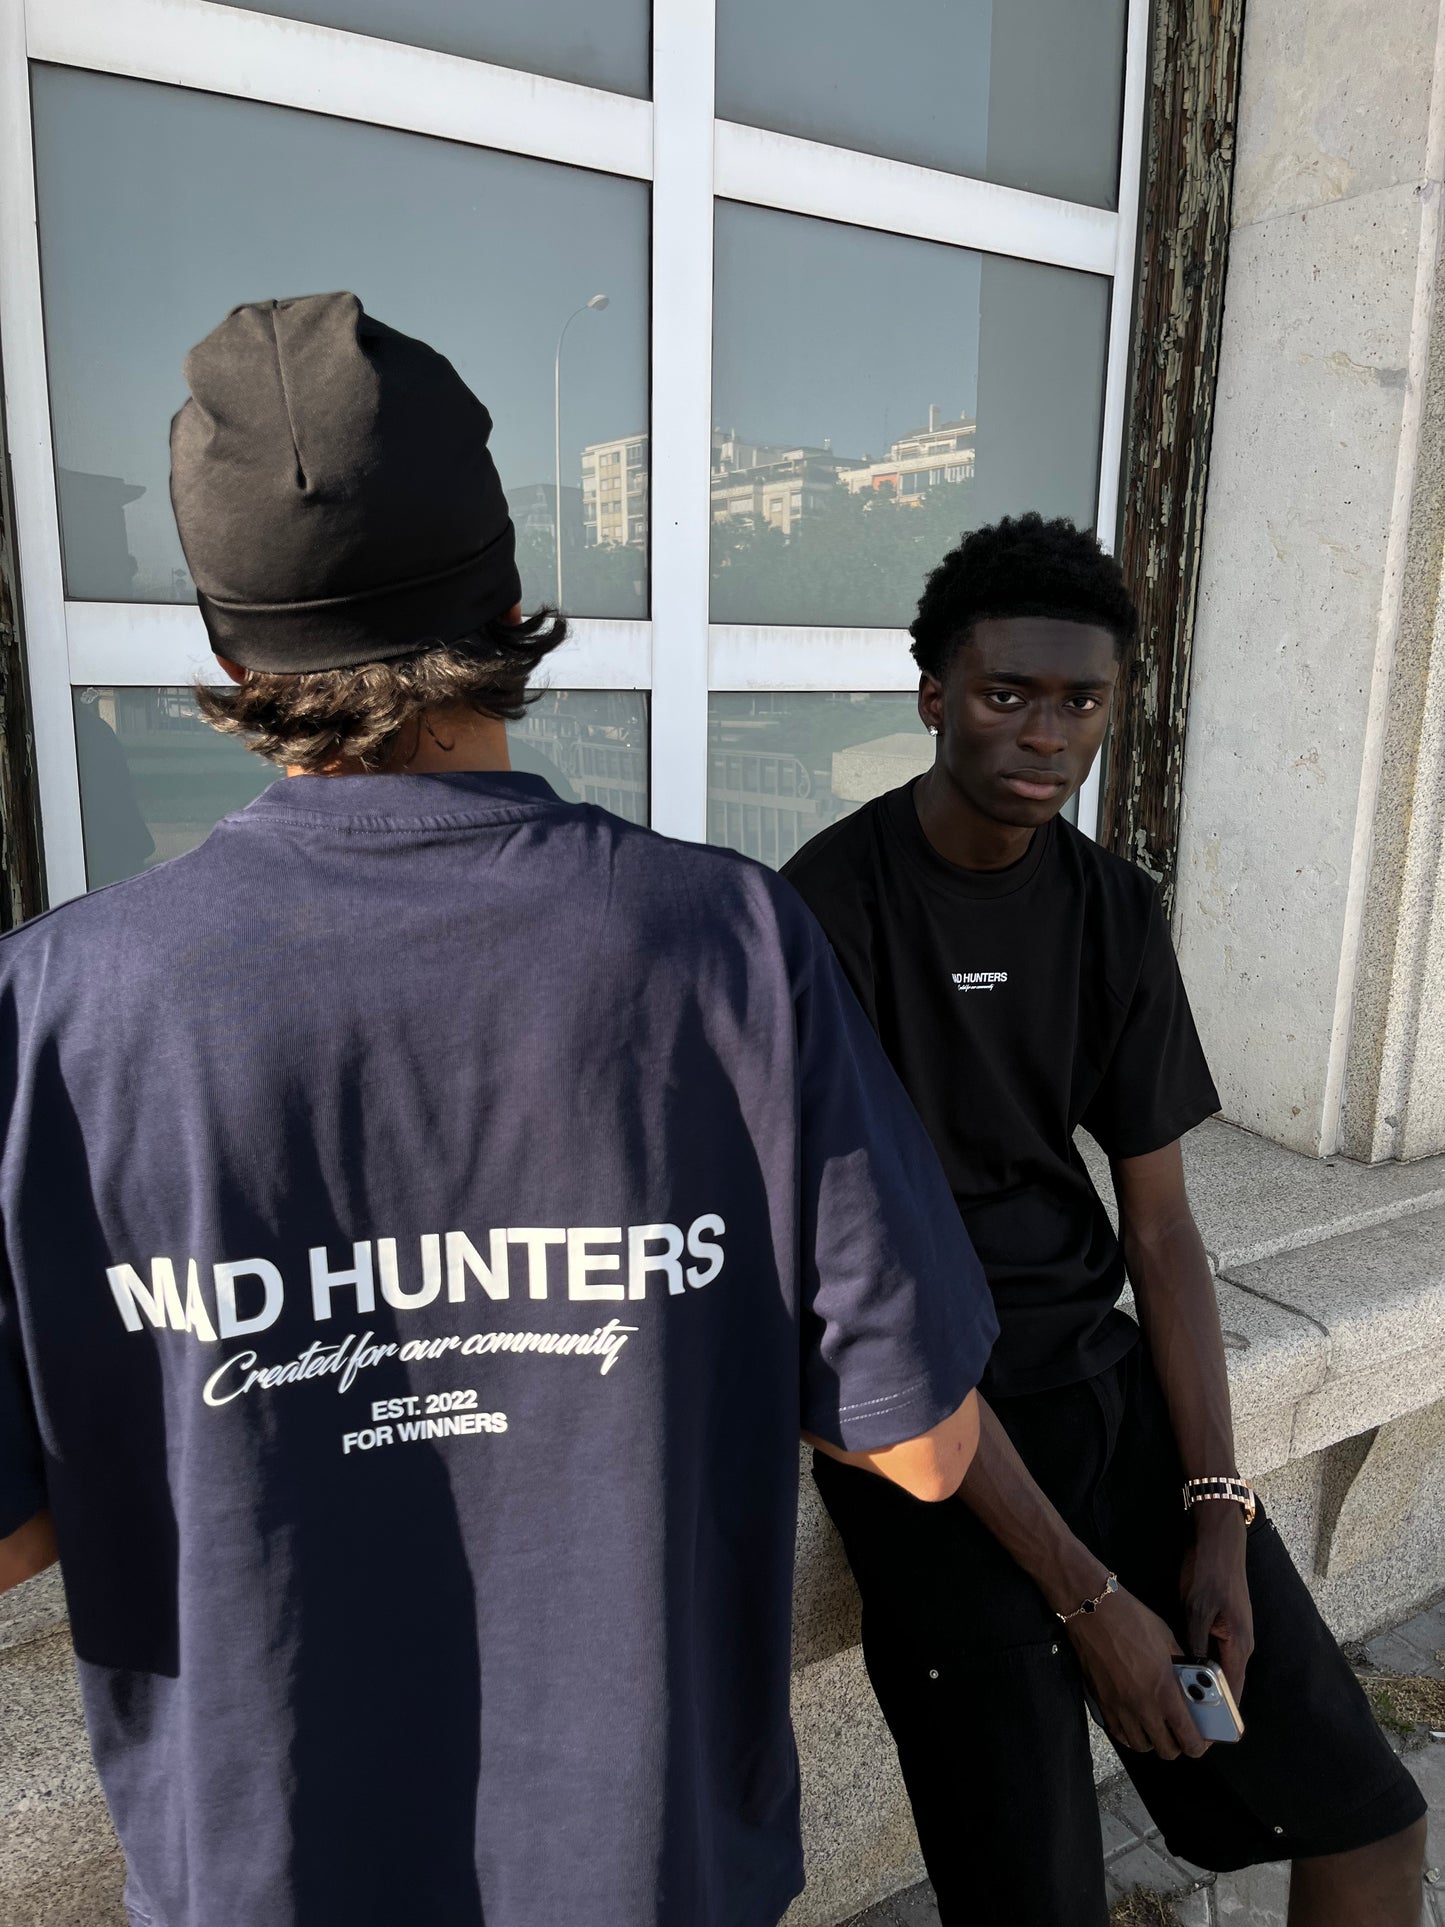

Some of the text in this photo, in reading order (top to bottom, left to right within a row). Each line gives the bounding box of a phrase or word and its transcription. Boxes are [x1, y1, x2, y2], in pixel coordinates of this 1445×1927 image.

[963, 972, 1008, 983] HUNTERS
[105, 1213, 726, 1342] MAD HUNTERS
[203, 1318, 639, 1407] Created for our community
[371, 1389, 479, 1422] EST. 2022
[342, 1412, 508, 1455] FOR WINNERS
